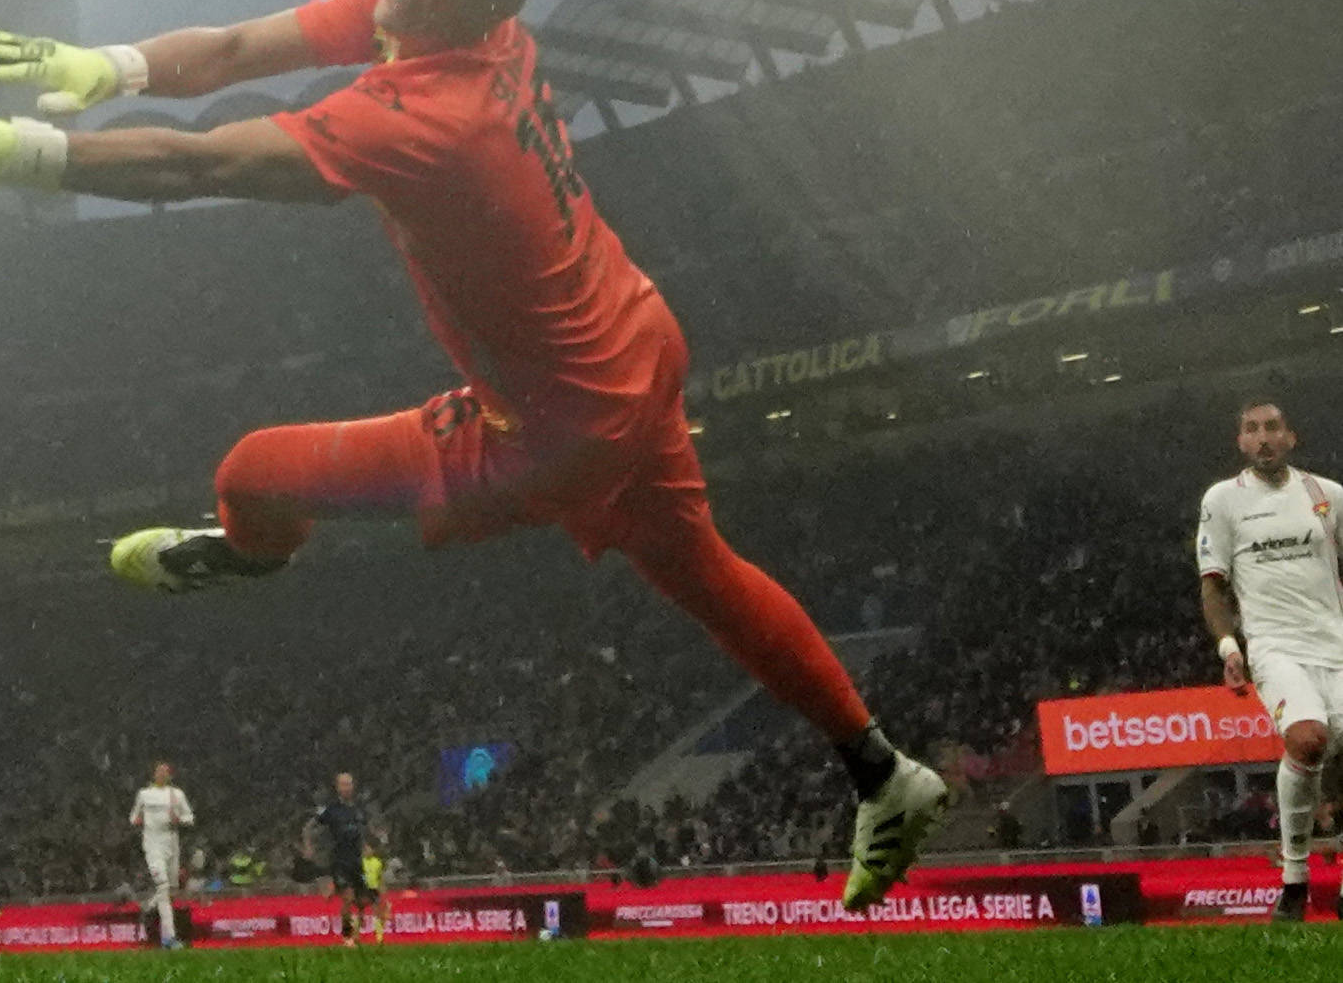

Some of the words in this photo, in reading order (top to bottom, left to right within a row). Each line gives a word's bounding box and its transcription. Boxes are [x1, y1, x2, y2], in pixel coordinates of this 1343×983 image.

[712, 332, 881, 400] CATTOLICA
[721, 900, 778, 926] TRENO
[868, 896, 925, 922] DELLA
[928, 894, 980, 921] LEGA
[982, 894, 1033, 920] SERIE
[1037, 893, 1055, 919] A
